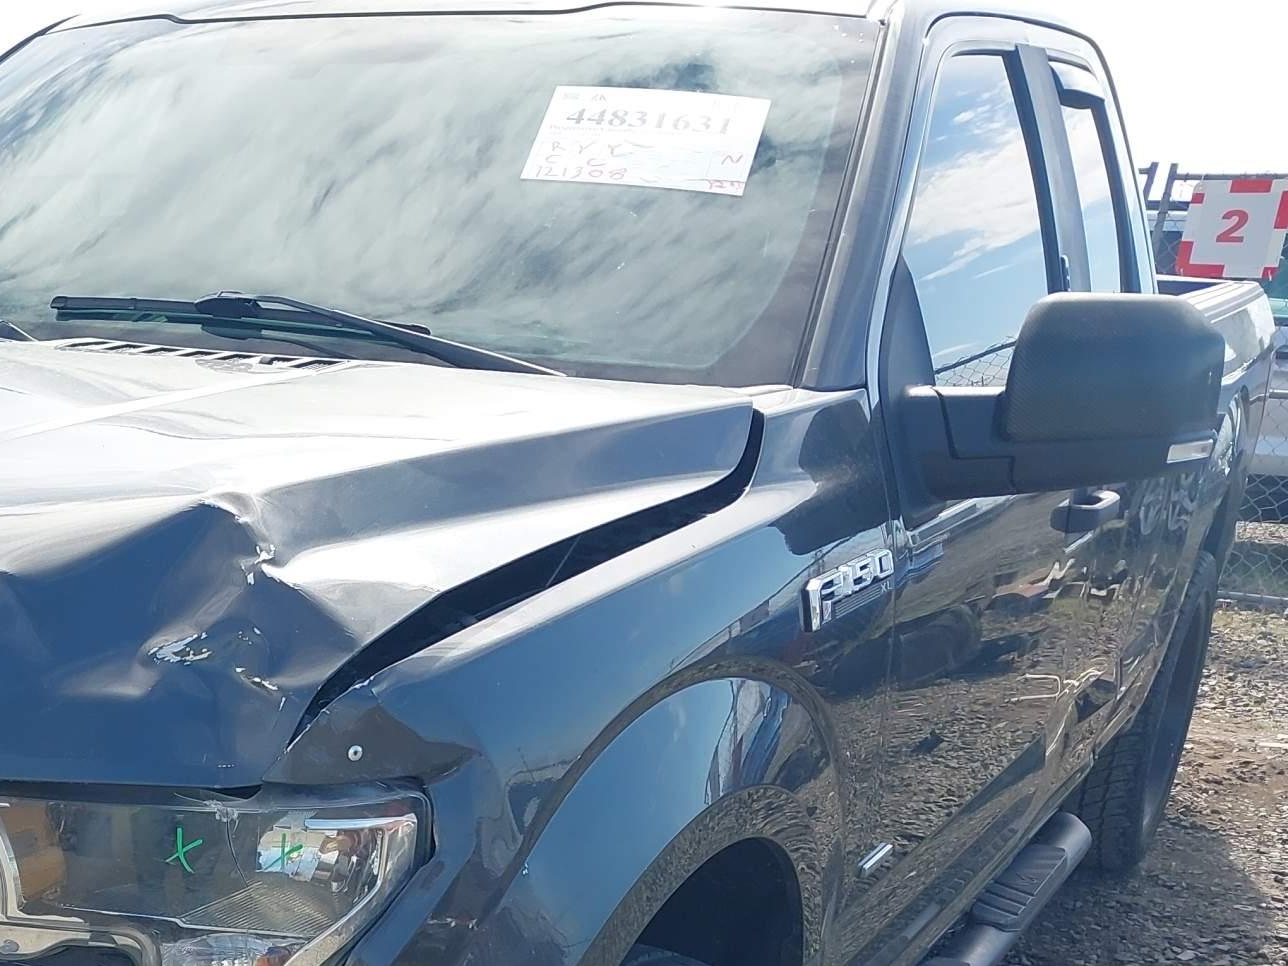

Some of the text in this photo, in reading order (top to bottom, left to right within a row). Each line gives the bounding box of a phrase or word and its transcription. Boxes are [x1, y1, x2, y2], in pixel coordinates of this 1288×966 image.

[565, 107, 732, 135] 44831631
[1216, 209, 1249, 243] 2
[880, 580, 893, 593] XL
